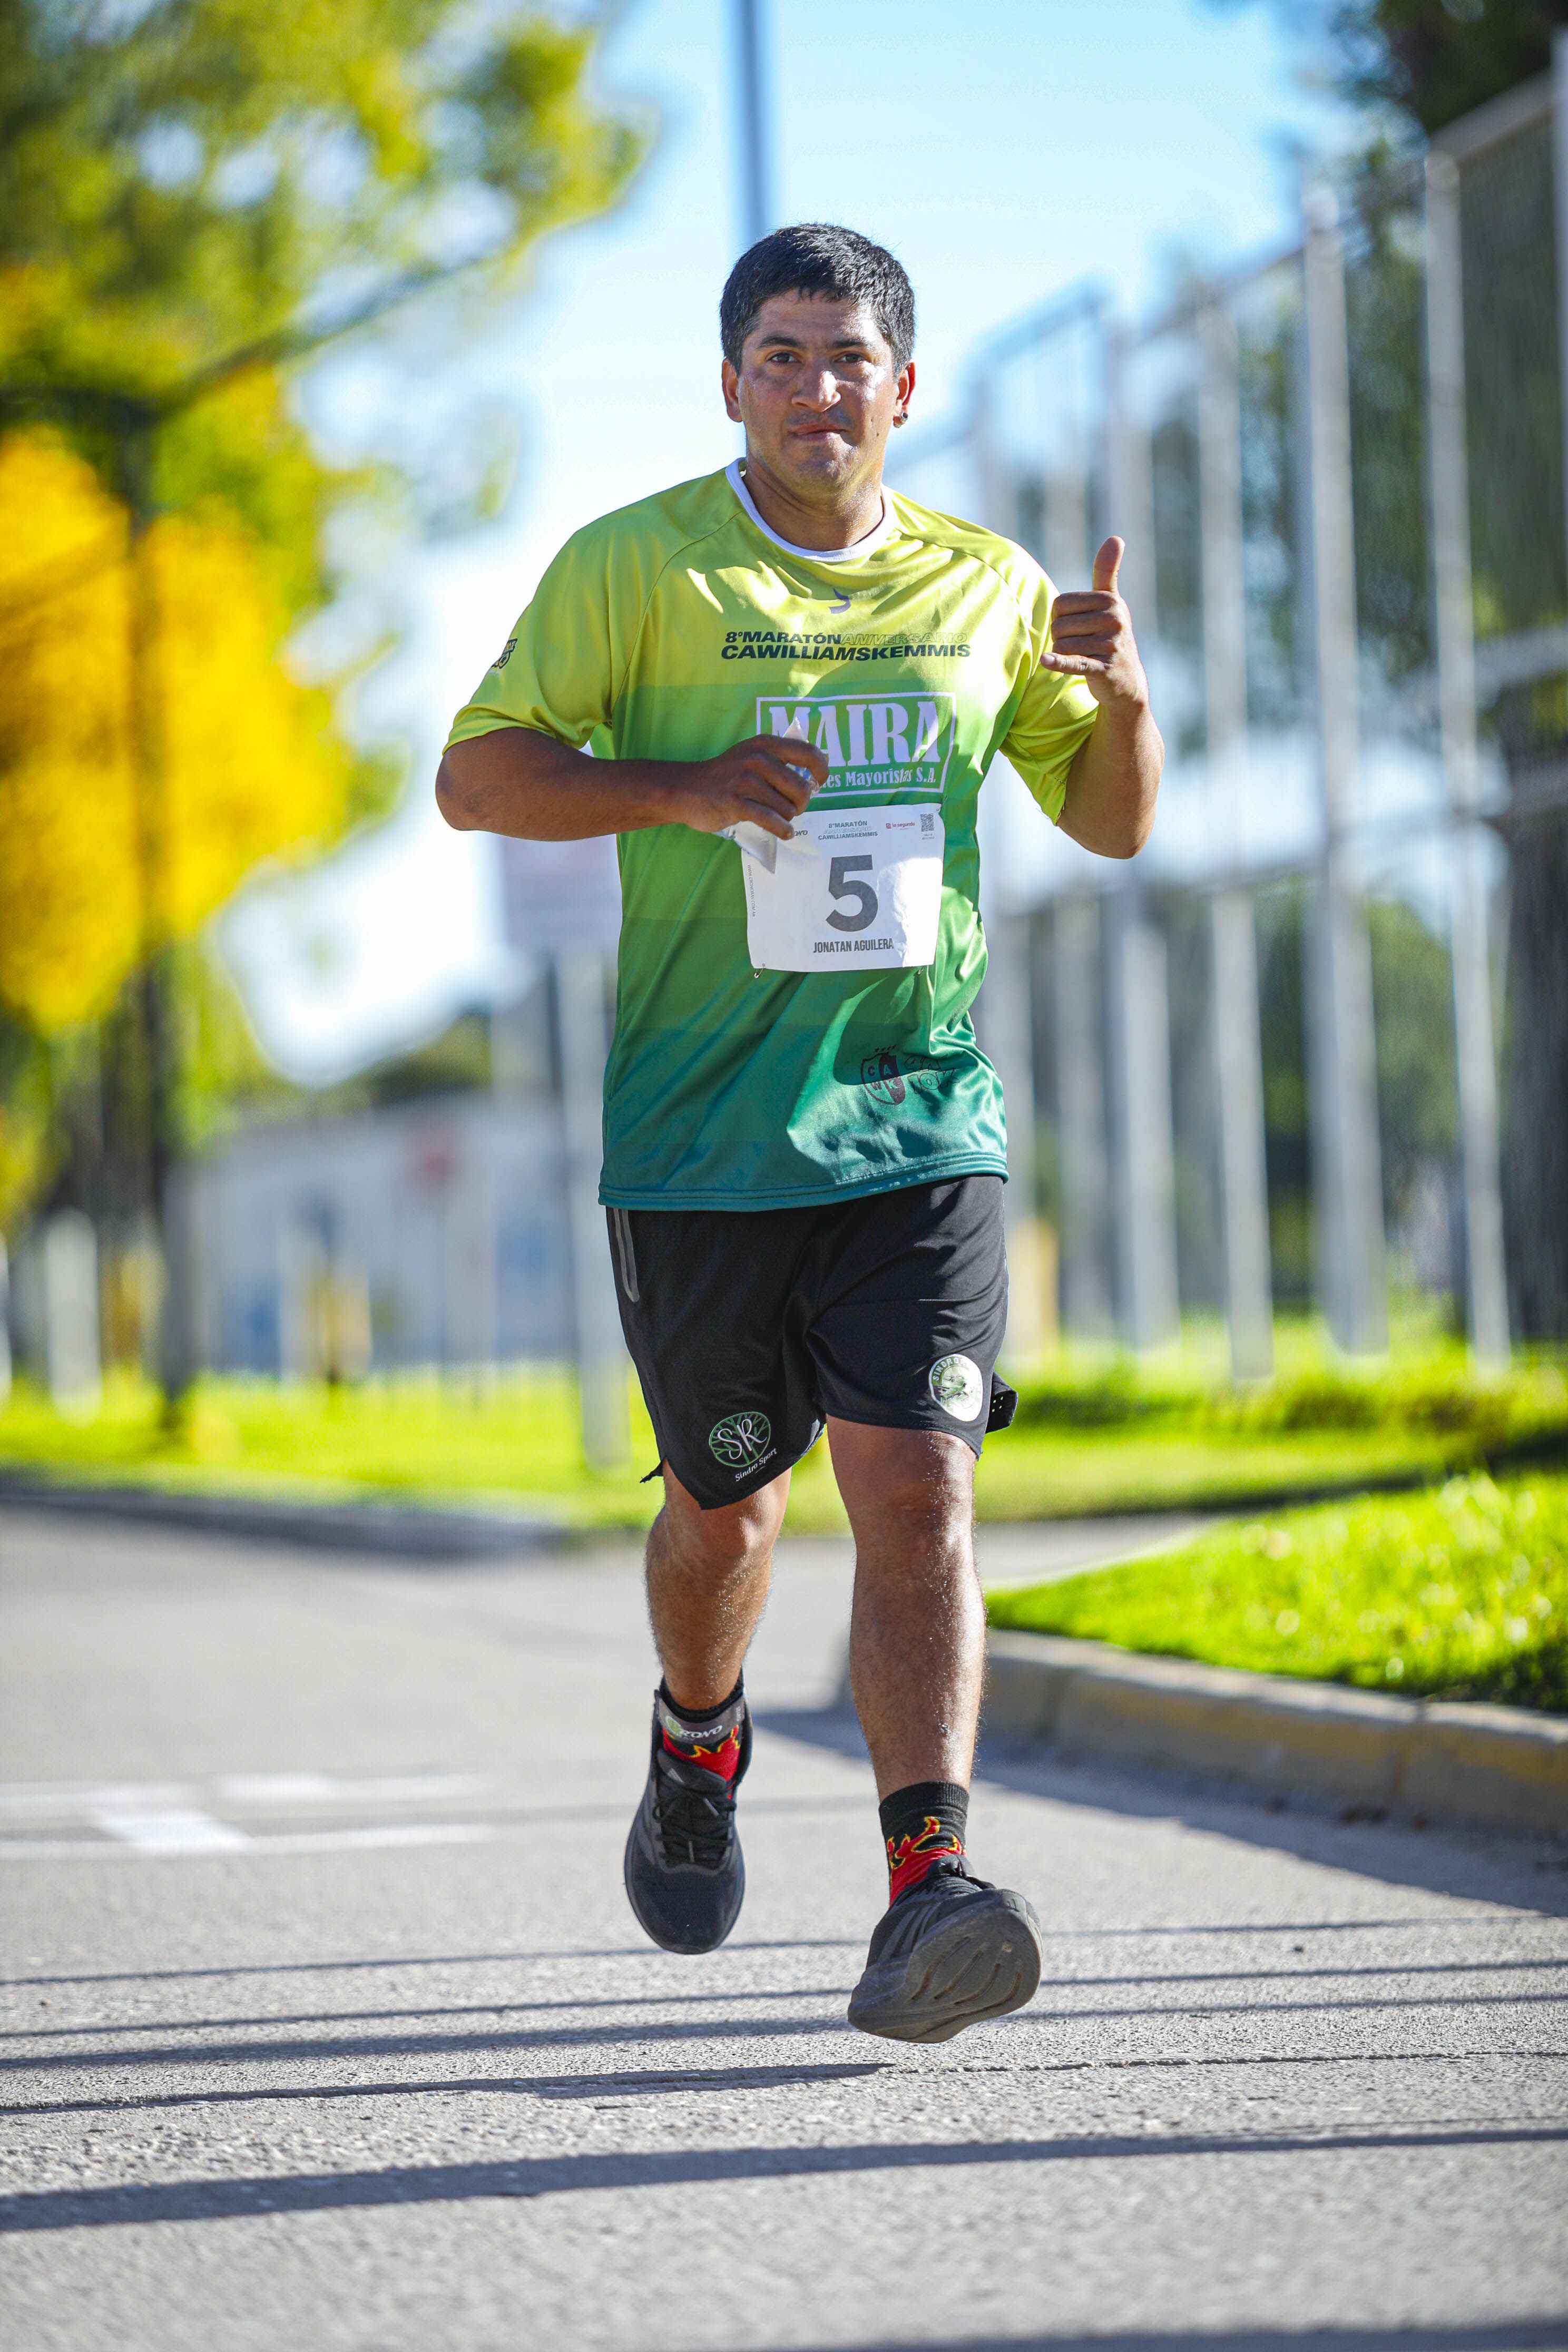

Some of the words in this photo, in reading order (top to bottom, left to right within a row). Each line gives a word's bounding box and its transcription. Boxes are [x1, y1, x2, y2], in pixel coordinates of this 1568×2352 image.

[721, 644, 971, 661] CAWILLIAMSKEMMIS
[916, 767, 936, 783] S.A.
[818, 831, 878, 840] CAWILLIAMSKEMMIS
[826, 854, 879, 932] 5
[814, 940, 852, 953] JONATAN
[854, 938, 894, 952] AGUILERA
[907, 1069, 960, 1094] 10K
[735, 1463, 758, 1482] Sindro
[759, 1448, 778, 1465] Sport
